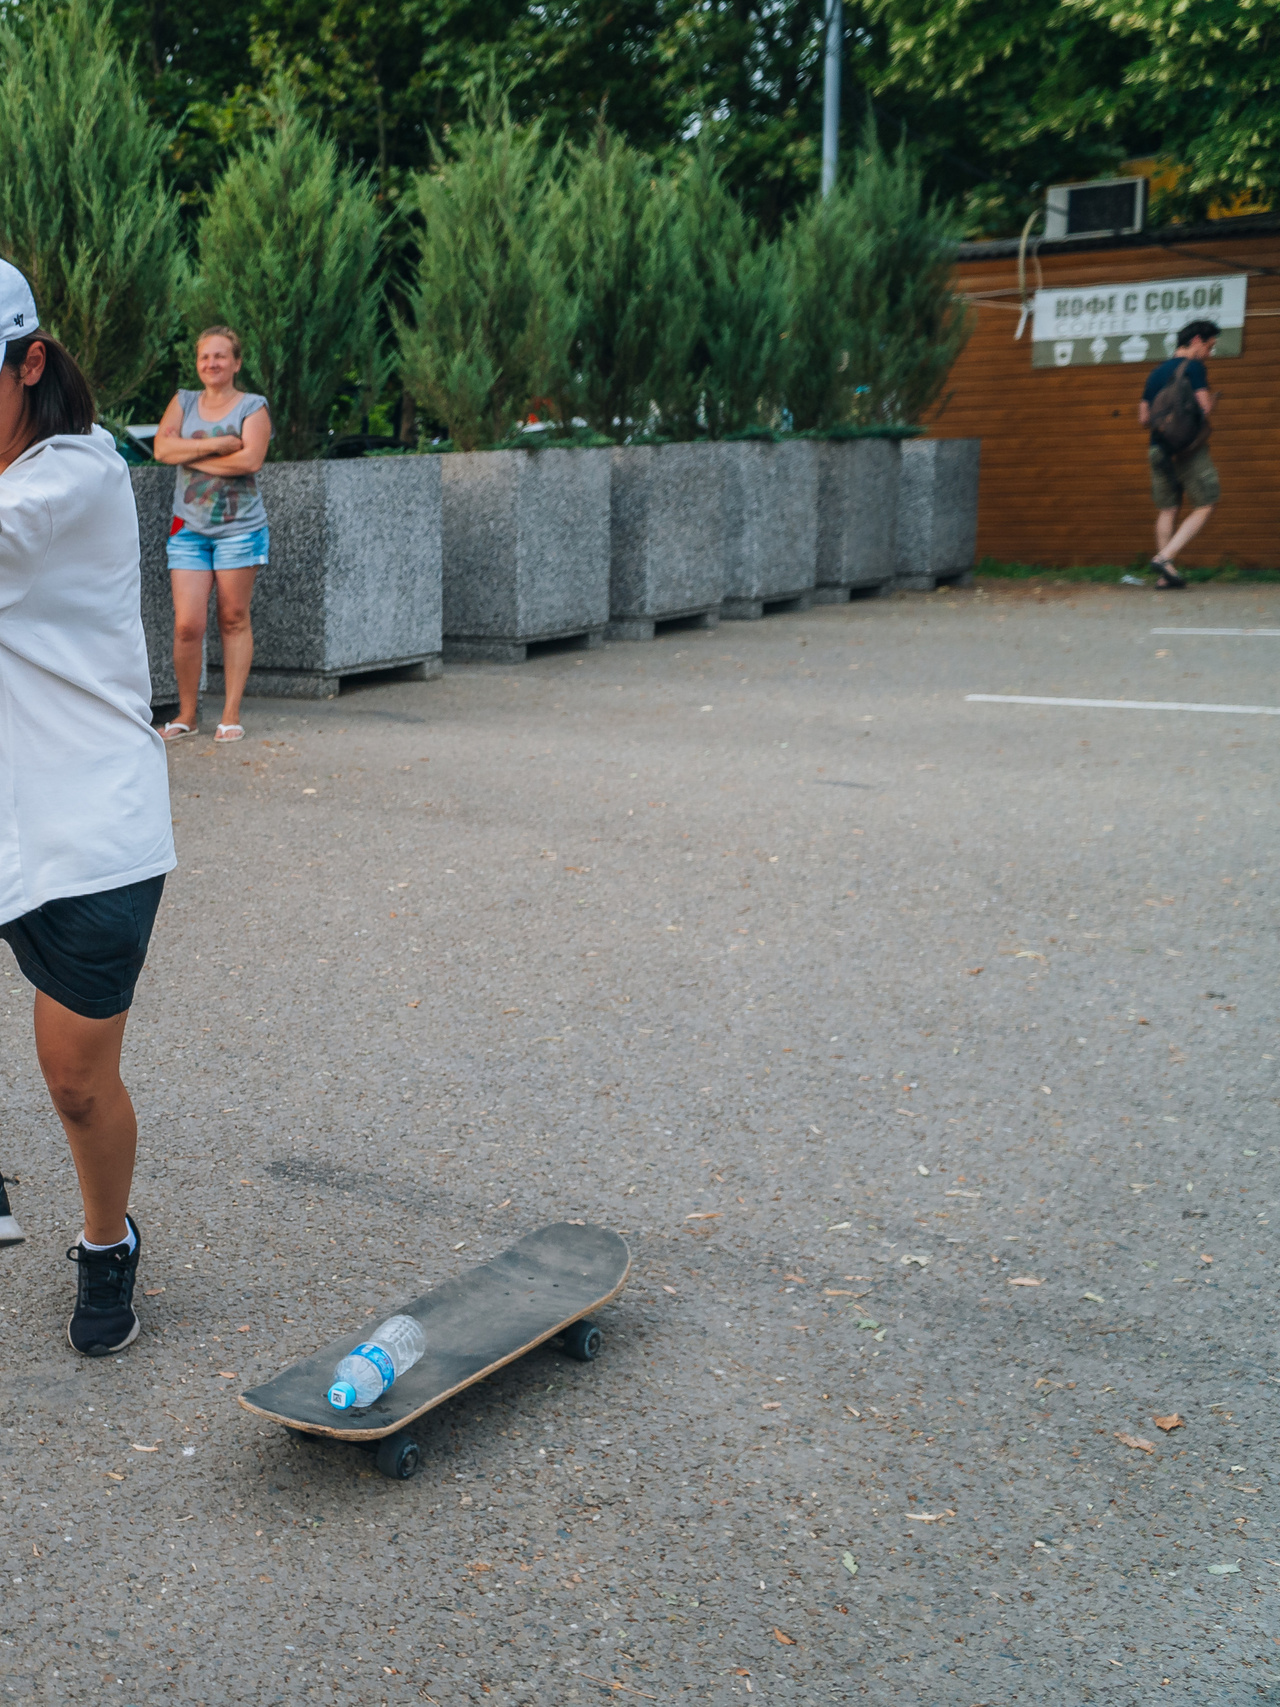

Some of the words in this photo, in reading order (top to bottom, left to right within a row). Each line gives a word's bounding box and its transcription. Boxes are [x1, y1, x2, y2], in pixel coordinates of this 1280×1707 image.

[1055, 294, 1117, 318] КОФЕ
[1123, 292, 1138, 314] С
[1144, 281, 1224, 312] СОБОЙ
